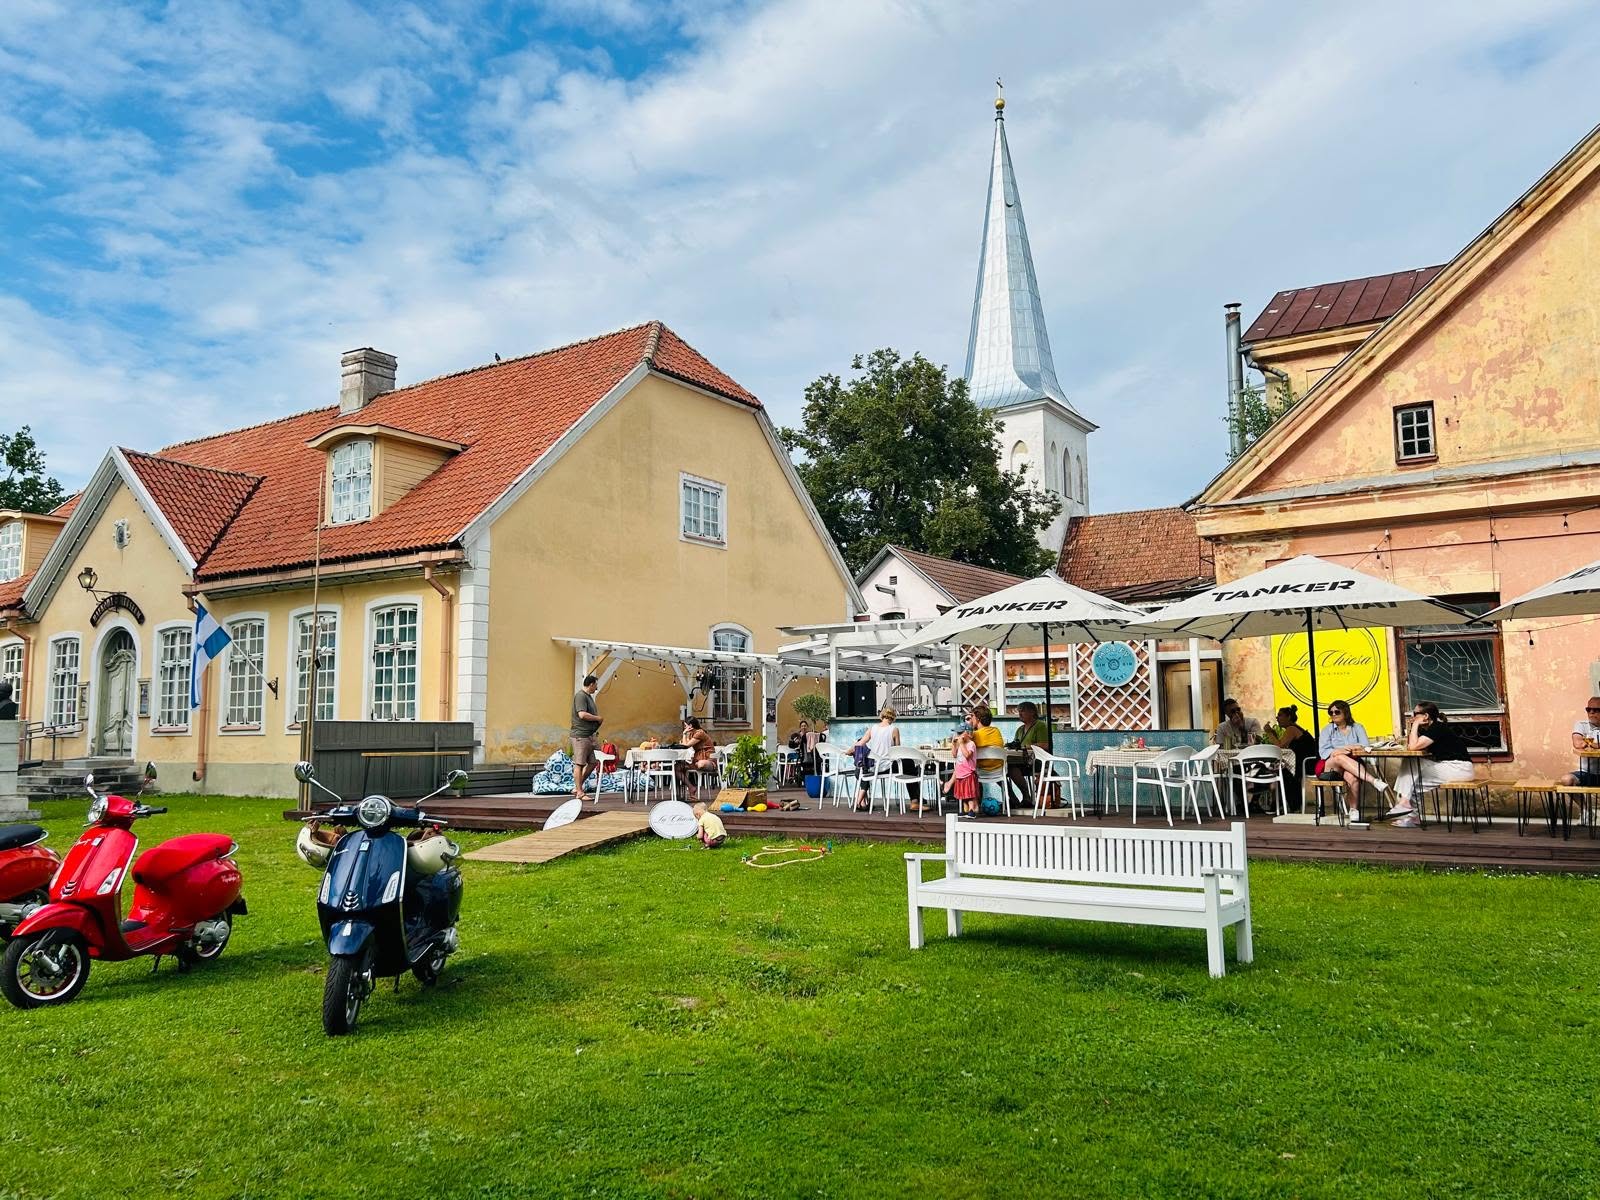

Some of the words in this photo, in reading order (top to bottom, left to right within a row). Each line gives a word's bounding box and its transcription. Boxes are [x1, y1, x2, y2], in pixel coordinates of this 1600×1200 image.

[1211, 580, 1356, 602] TANKER
[956, 600, 1068, 619] TANKER
[1317, 649, 1373, 668] Chiesa
